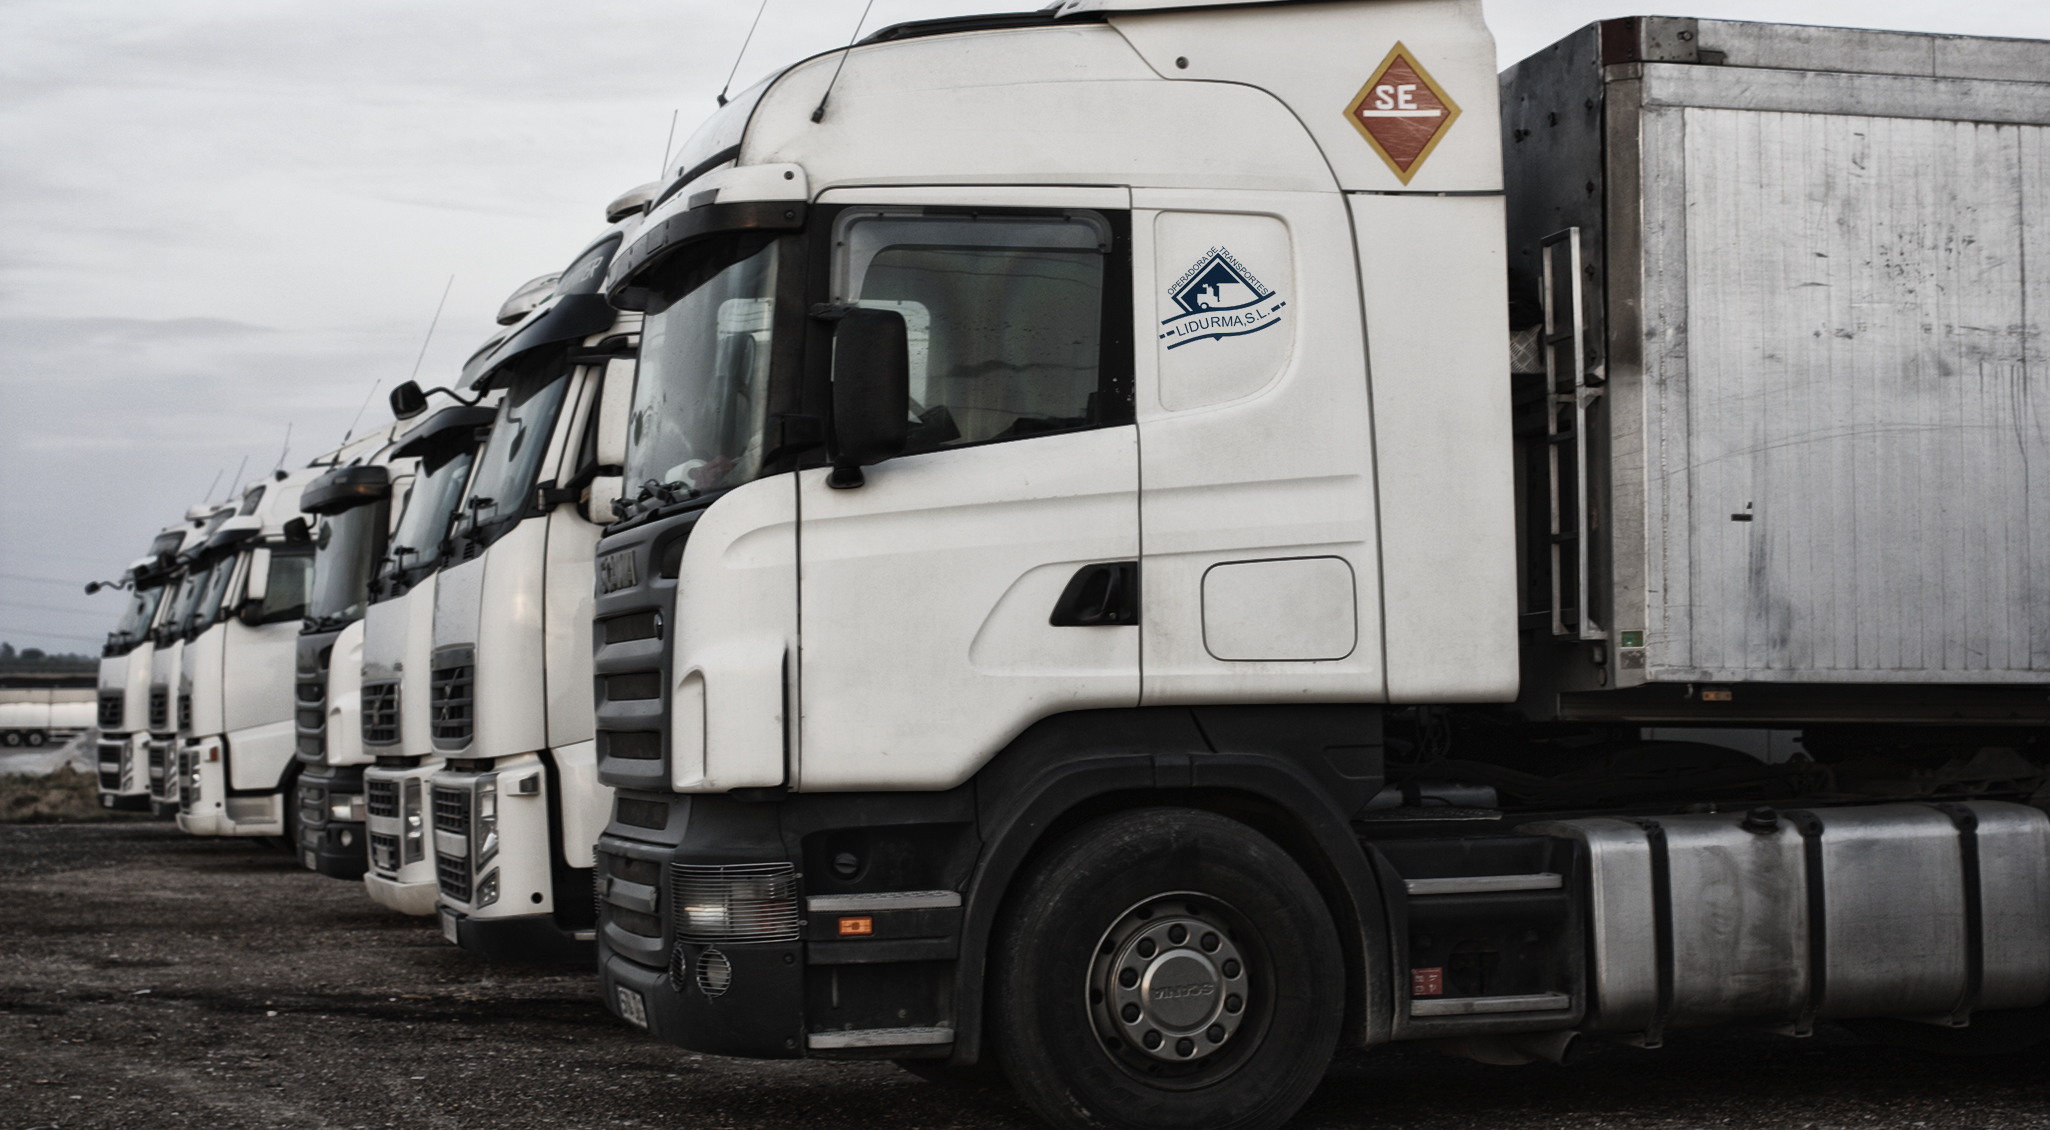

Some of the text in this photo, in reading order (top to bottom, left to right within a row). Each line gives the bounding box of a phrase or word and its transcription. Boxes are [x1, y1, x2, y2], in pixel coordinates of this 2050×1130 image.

[1375, 84, 1417, 110] SE
[1167, 245, 1269, 296] OPERADORA DE TRANSPORTES
